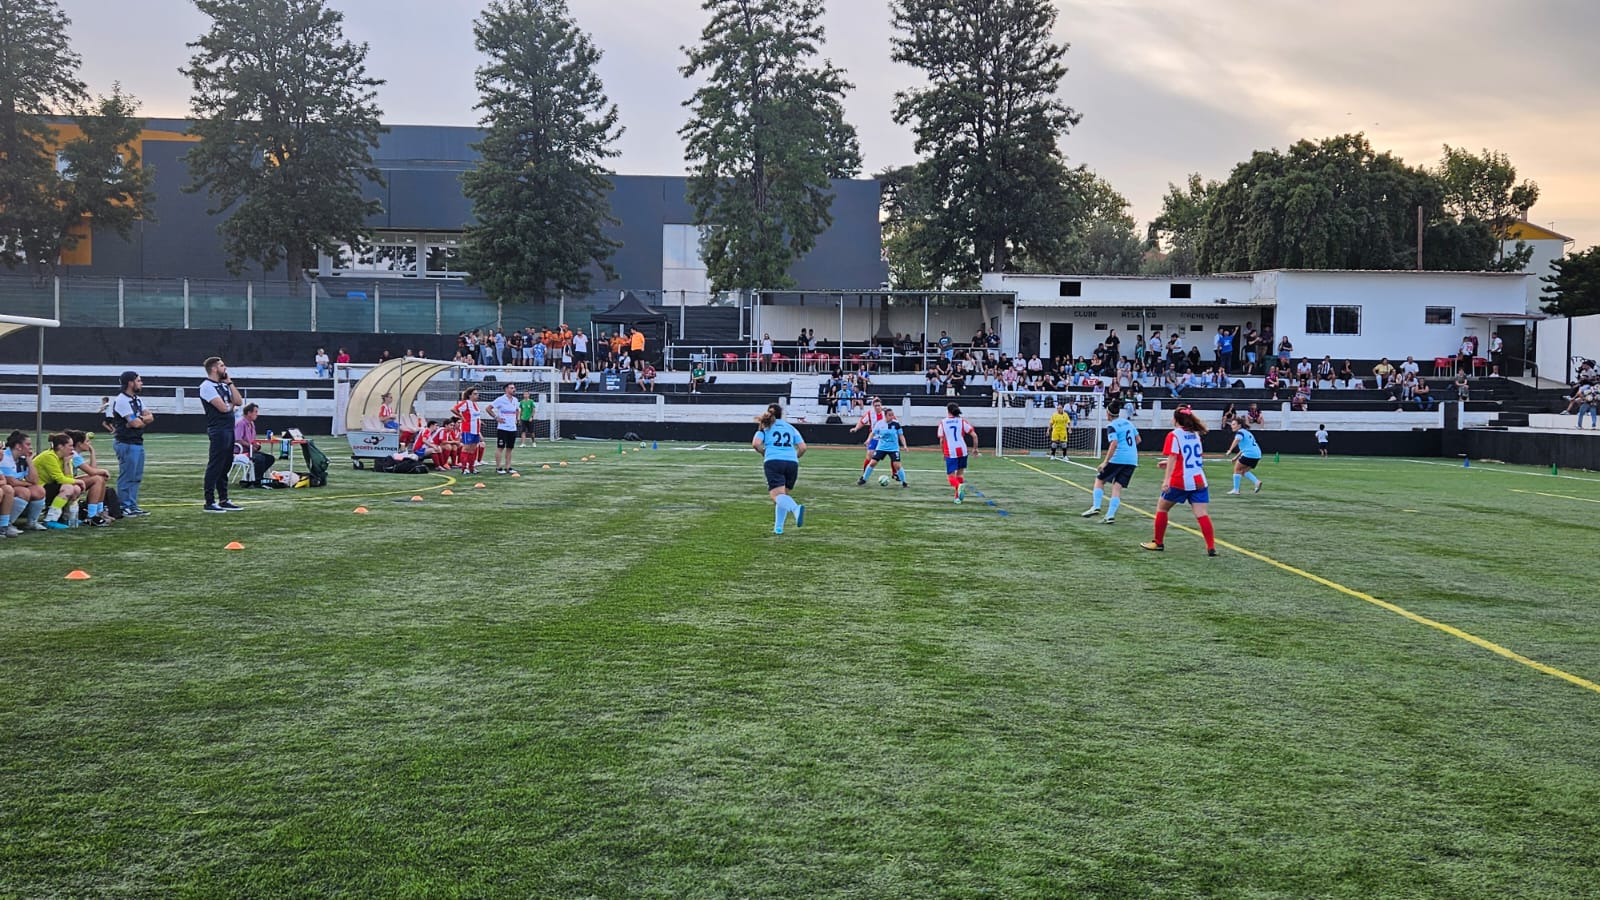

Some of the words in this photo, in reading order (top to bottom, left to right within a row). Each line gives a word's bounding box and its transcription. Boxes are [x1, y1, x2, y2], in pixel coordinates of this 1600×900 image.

[1121, 311, 1157, 319] ATLETCO
[772, 431, 792, 448] 22
[949, 425, 957, 441] 7
[1125, 429, 1133, 447] 6
[1182, 443, 1203, 469] 29
